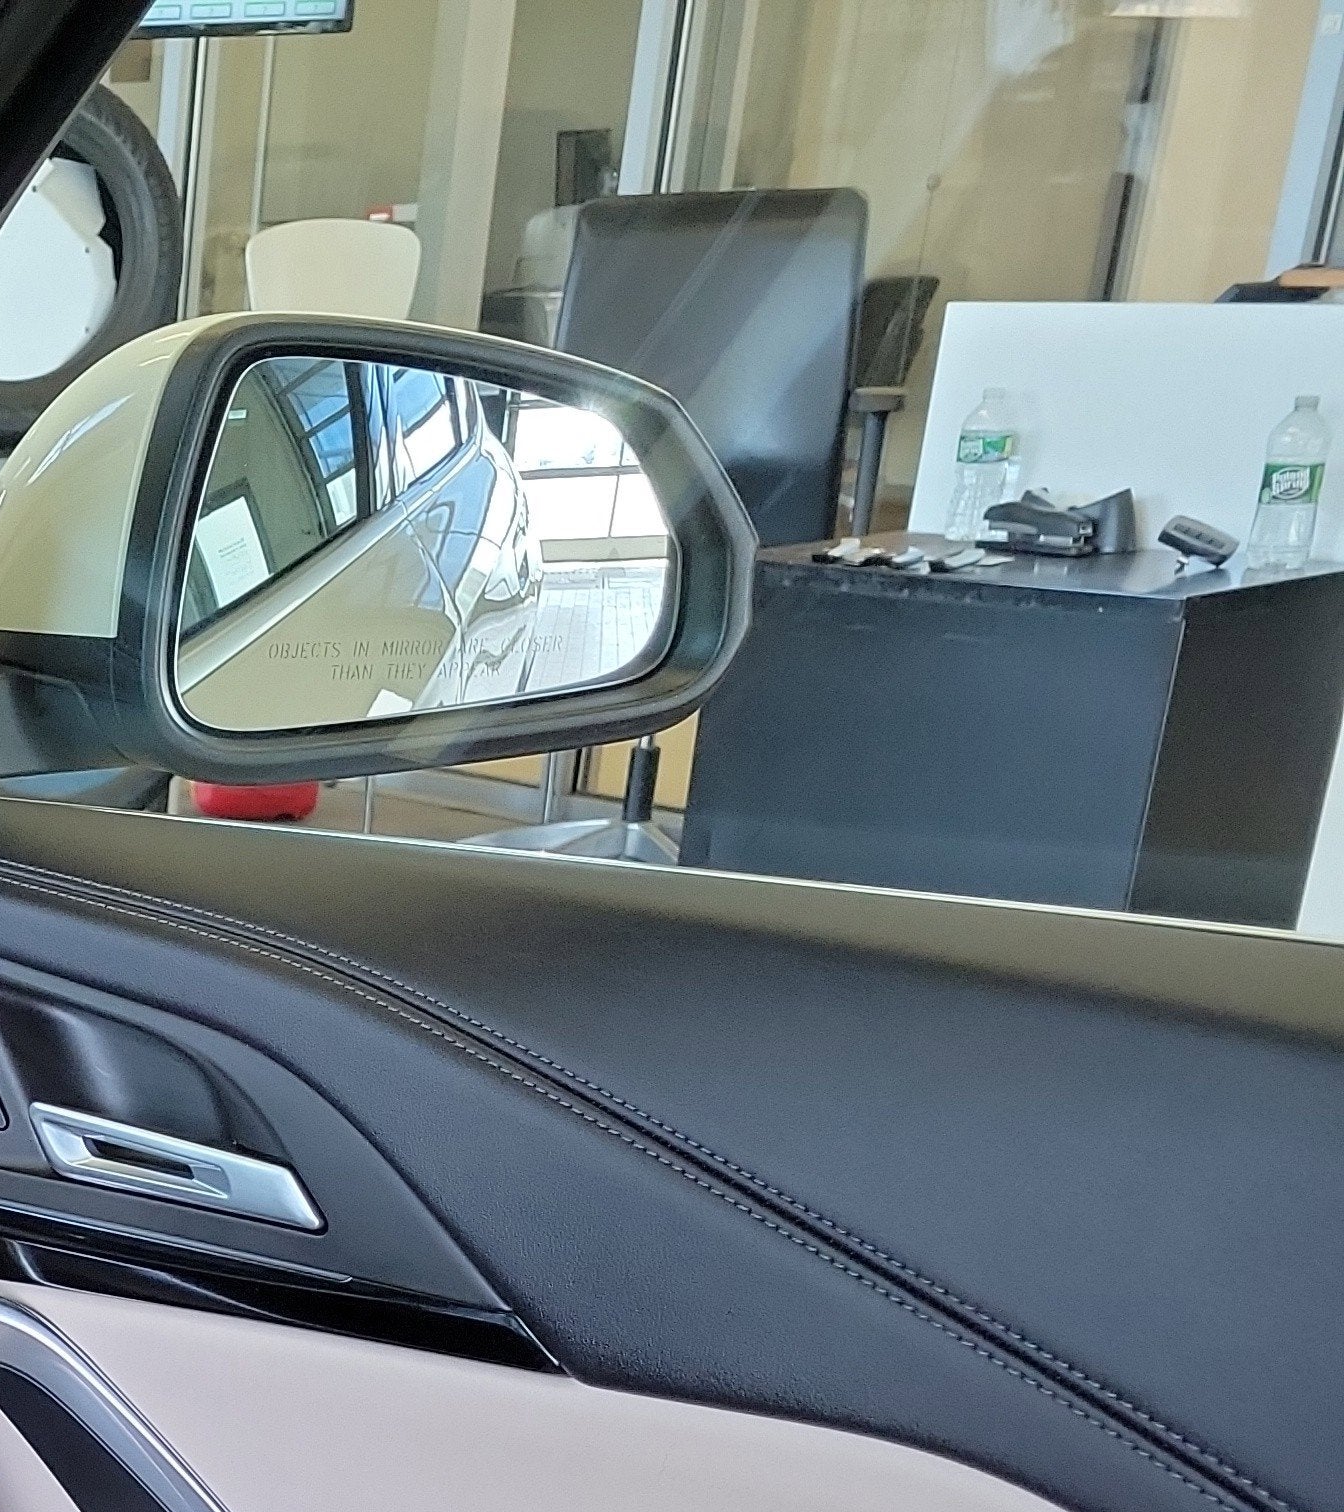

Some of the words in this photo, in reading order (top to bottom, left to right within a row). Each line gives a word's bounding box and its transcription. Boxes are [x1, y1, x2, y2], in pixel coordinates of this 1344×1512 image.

[268, 641, 342, 659] OBJECTS
[353, 641, 370, 658] IN
[381, 639, 443, 657] MIRROR
[330, 664, 373, 680] THAN
[387, 663, 426, 680] THEY
[437, 661, 500, 679] APPAR
